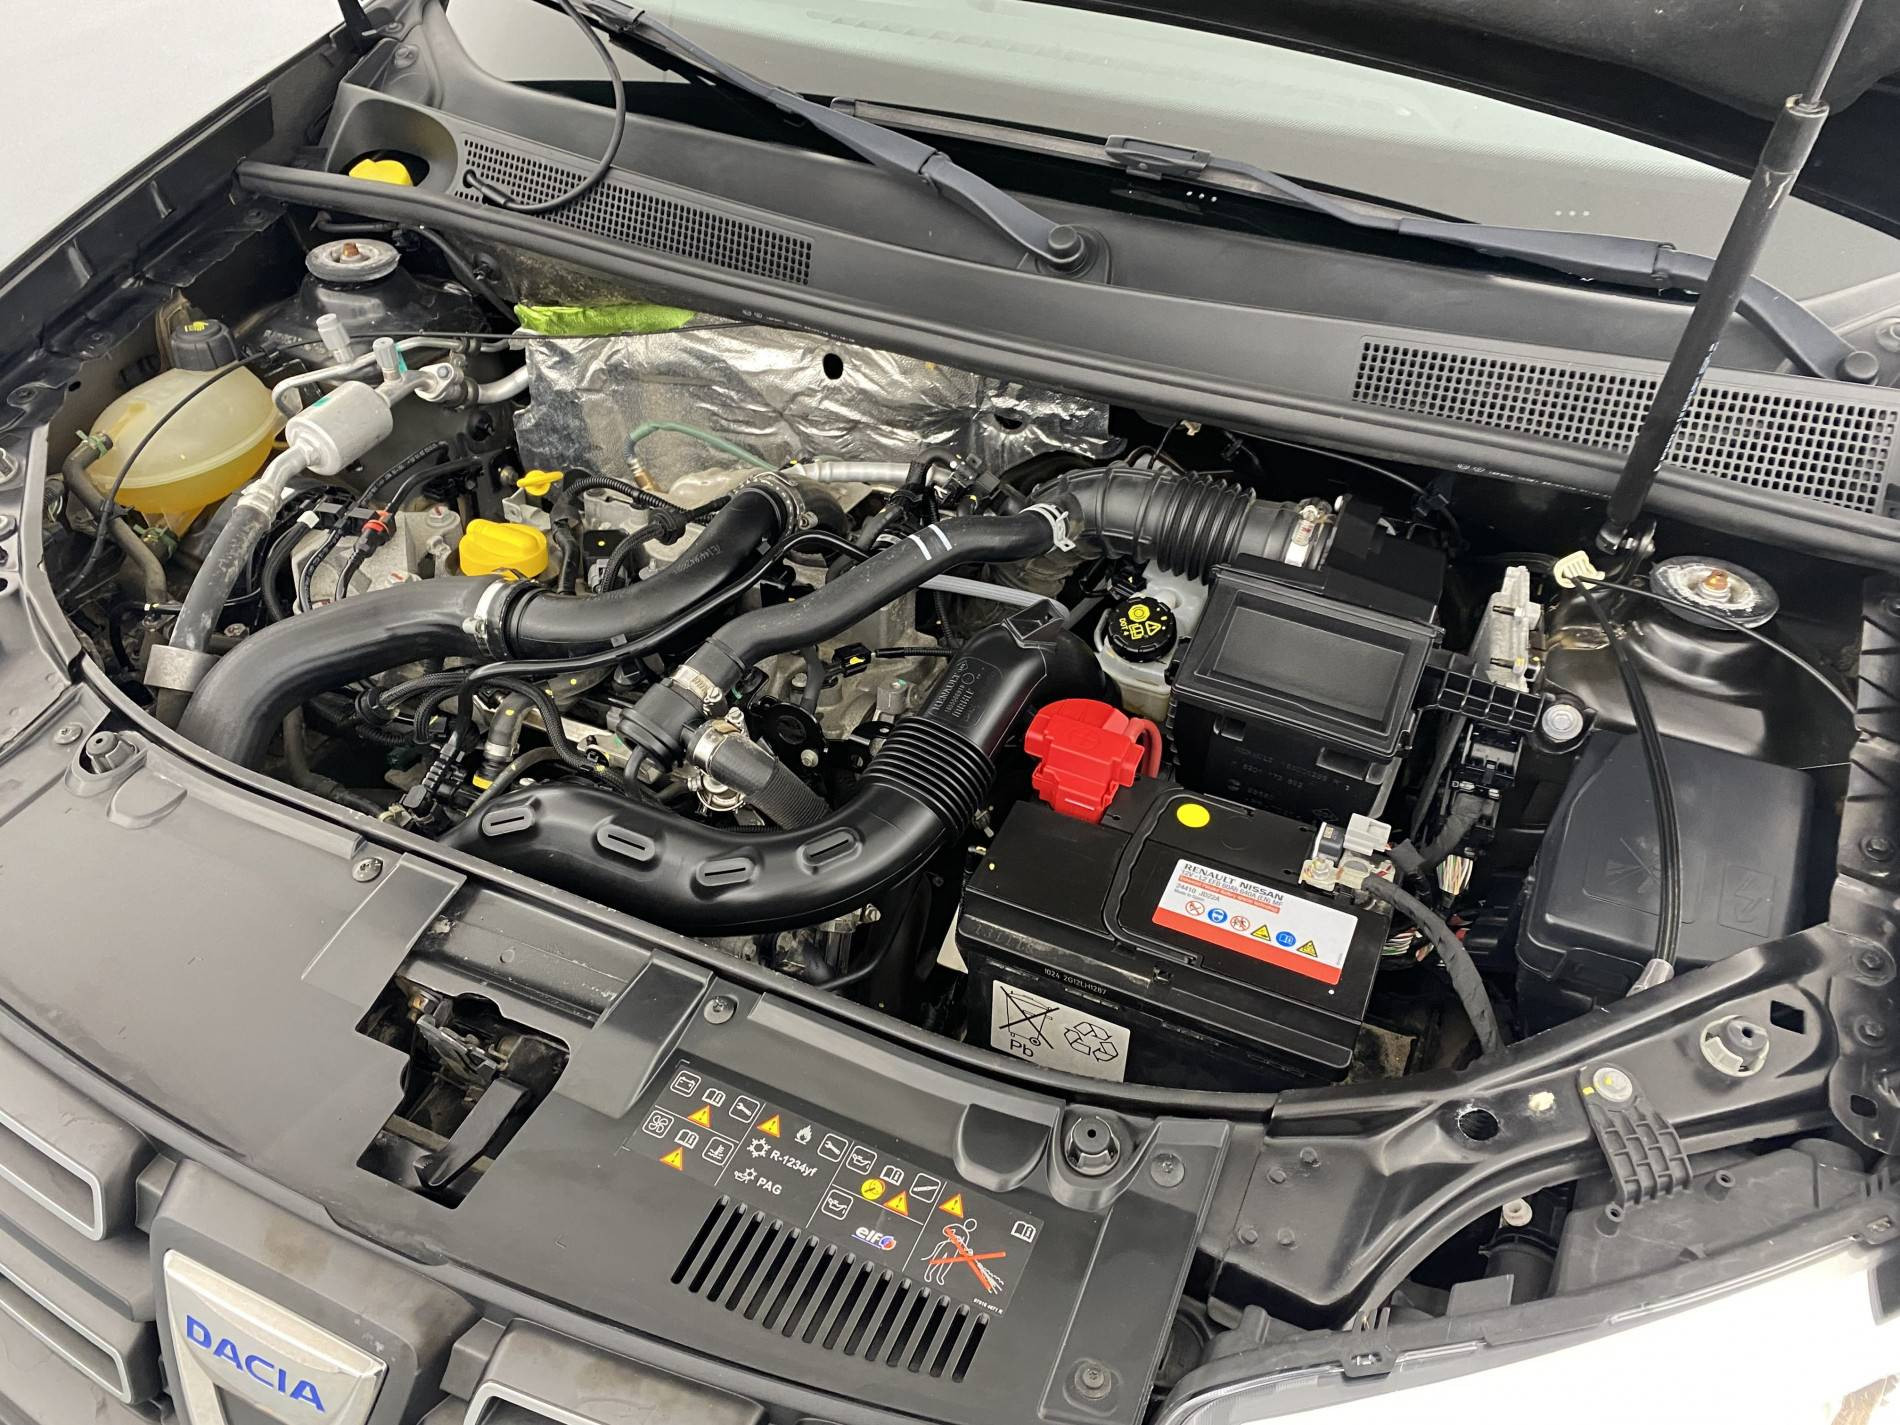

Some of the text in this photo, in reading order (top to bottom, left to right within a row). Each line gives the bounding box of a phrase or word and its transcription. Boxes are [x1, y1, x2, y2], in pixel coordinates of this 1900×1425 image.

[1119, 618, 1128, 629] DOT
[1184, 863, 1235, 885] RENAULT
[1239, 881, 1284, 901] NISSAN
[1044, 968, 1060, 979] 1024
[1010, 1039, 1034, 1057] Pb
[770, 1150, 818, 1177] R-1234yf
[756, 1177, 782, 1195] PAG
[855, 1226, 883, 1248] elf
[186, 1314, 325, 1412] DACIA
